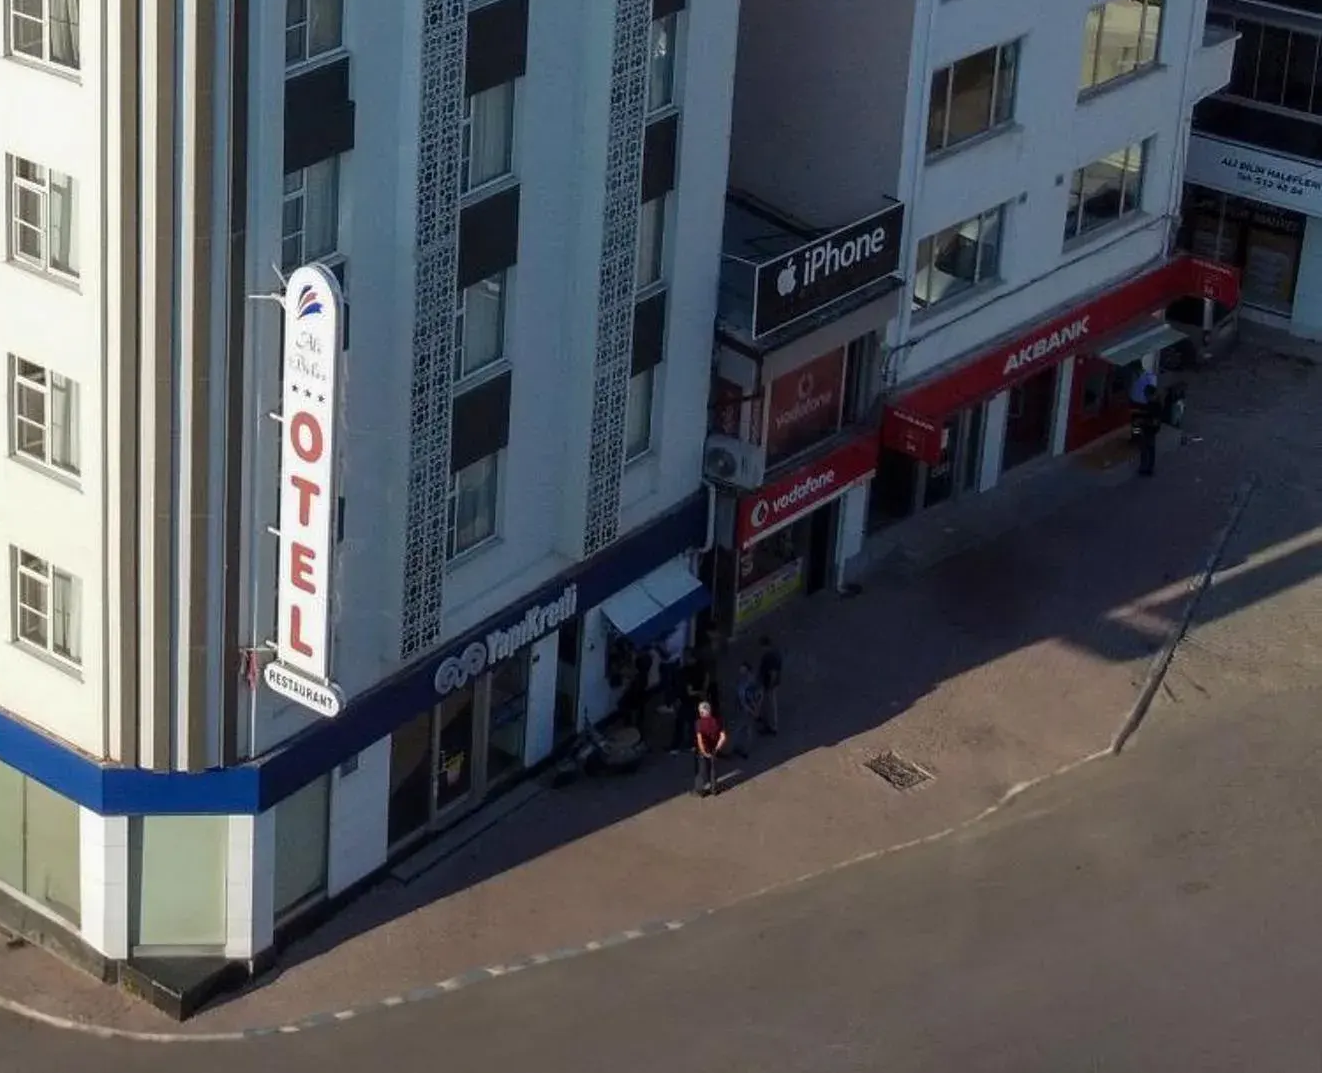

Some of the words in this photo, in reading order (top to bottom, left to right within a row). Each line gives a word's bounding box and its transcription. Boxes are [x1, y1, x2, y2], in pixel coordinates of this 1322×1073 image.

[804, 227, 885, 286] iPhone
[1003, 315, 1090, 375] AKBANK
[772, 469, 835, 514] vodafone
[290, 411, 323, 658] OTEL
[269, 669, 333, 709] RESTAURANT
